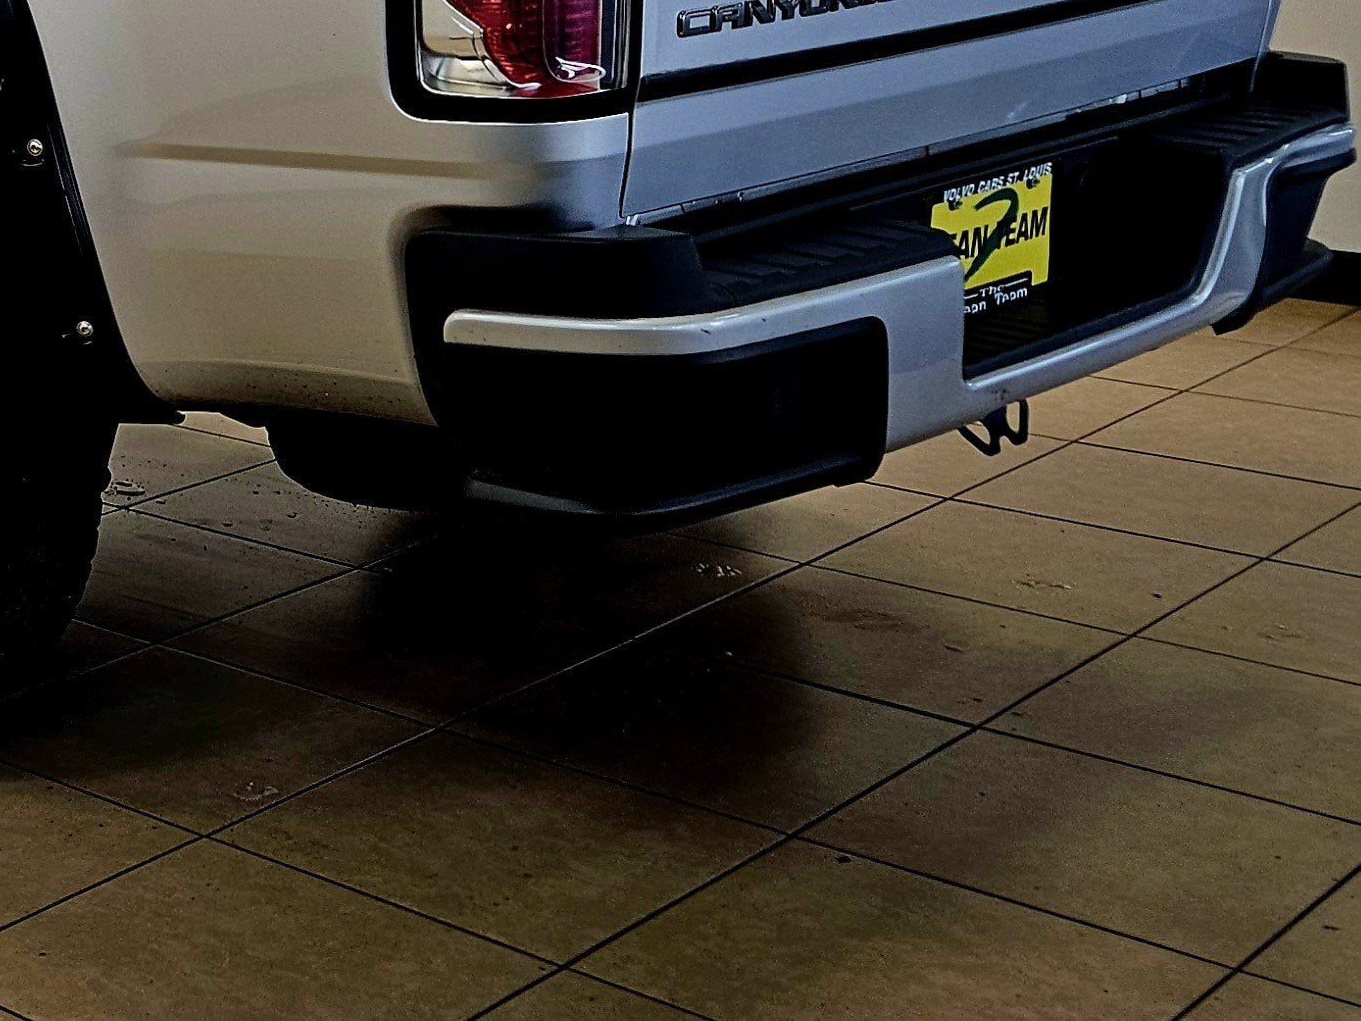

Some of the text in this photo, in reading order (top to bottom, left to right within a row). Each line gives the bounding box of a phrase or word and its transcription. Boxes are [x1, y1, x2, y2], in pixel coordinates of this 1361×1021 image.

[943, 183, 976, 203] VOLVO
[978, 175, 1005, 193] CARS
[1022, 162, 1053, 182] LOUIS
[979, 283, 1005, 298] The
[994, 287, 1028, 306] Team
